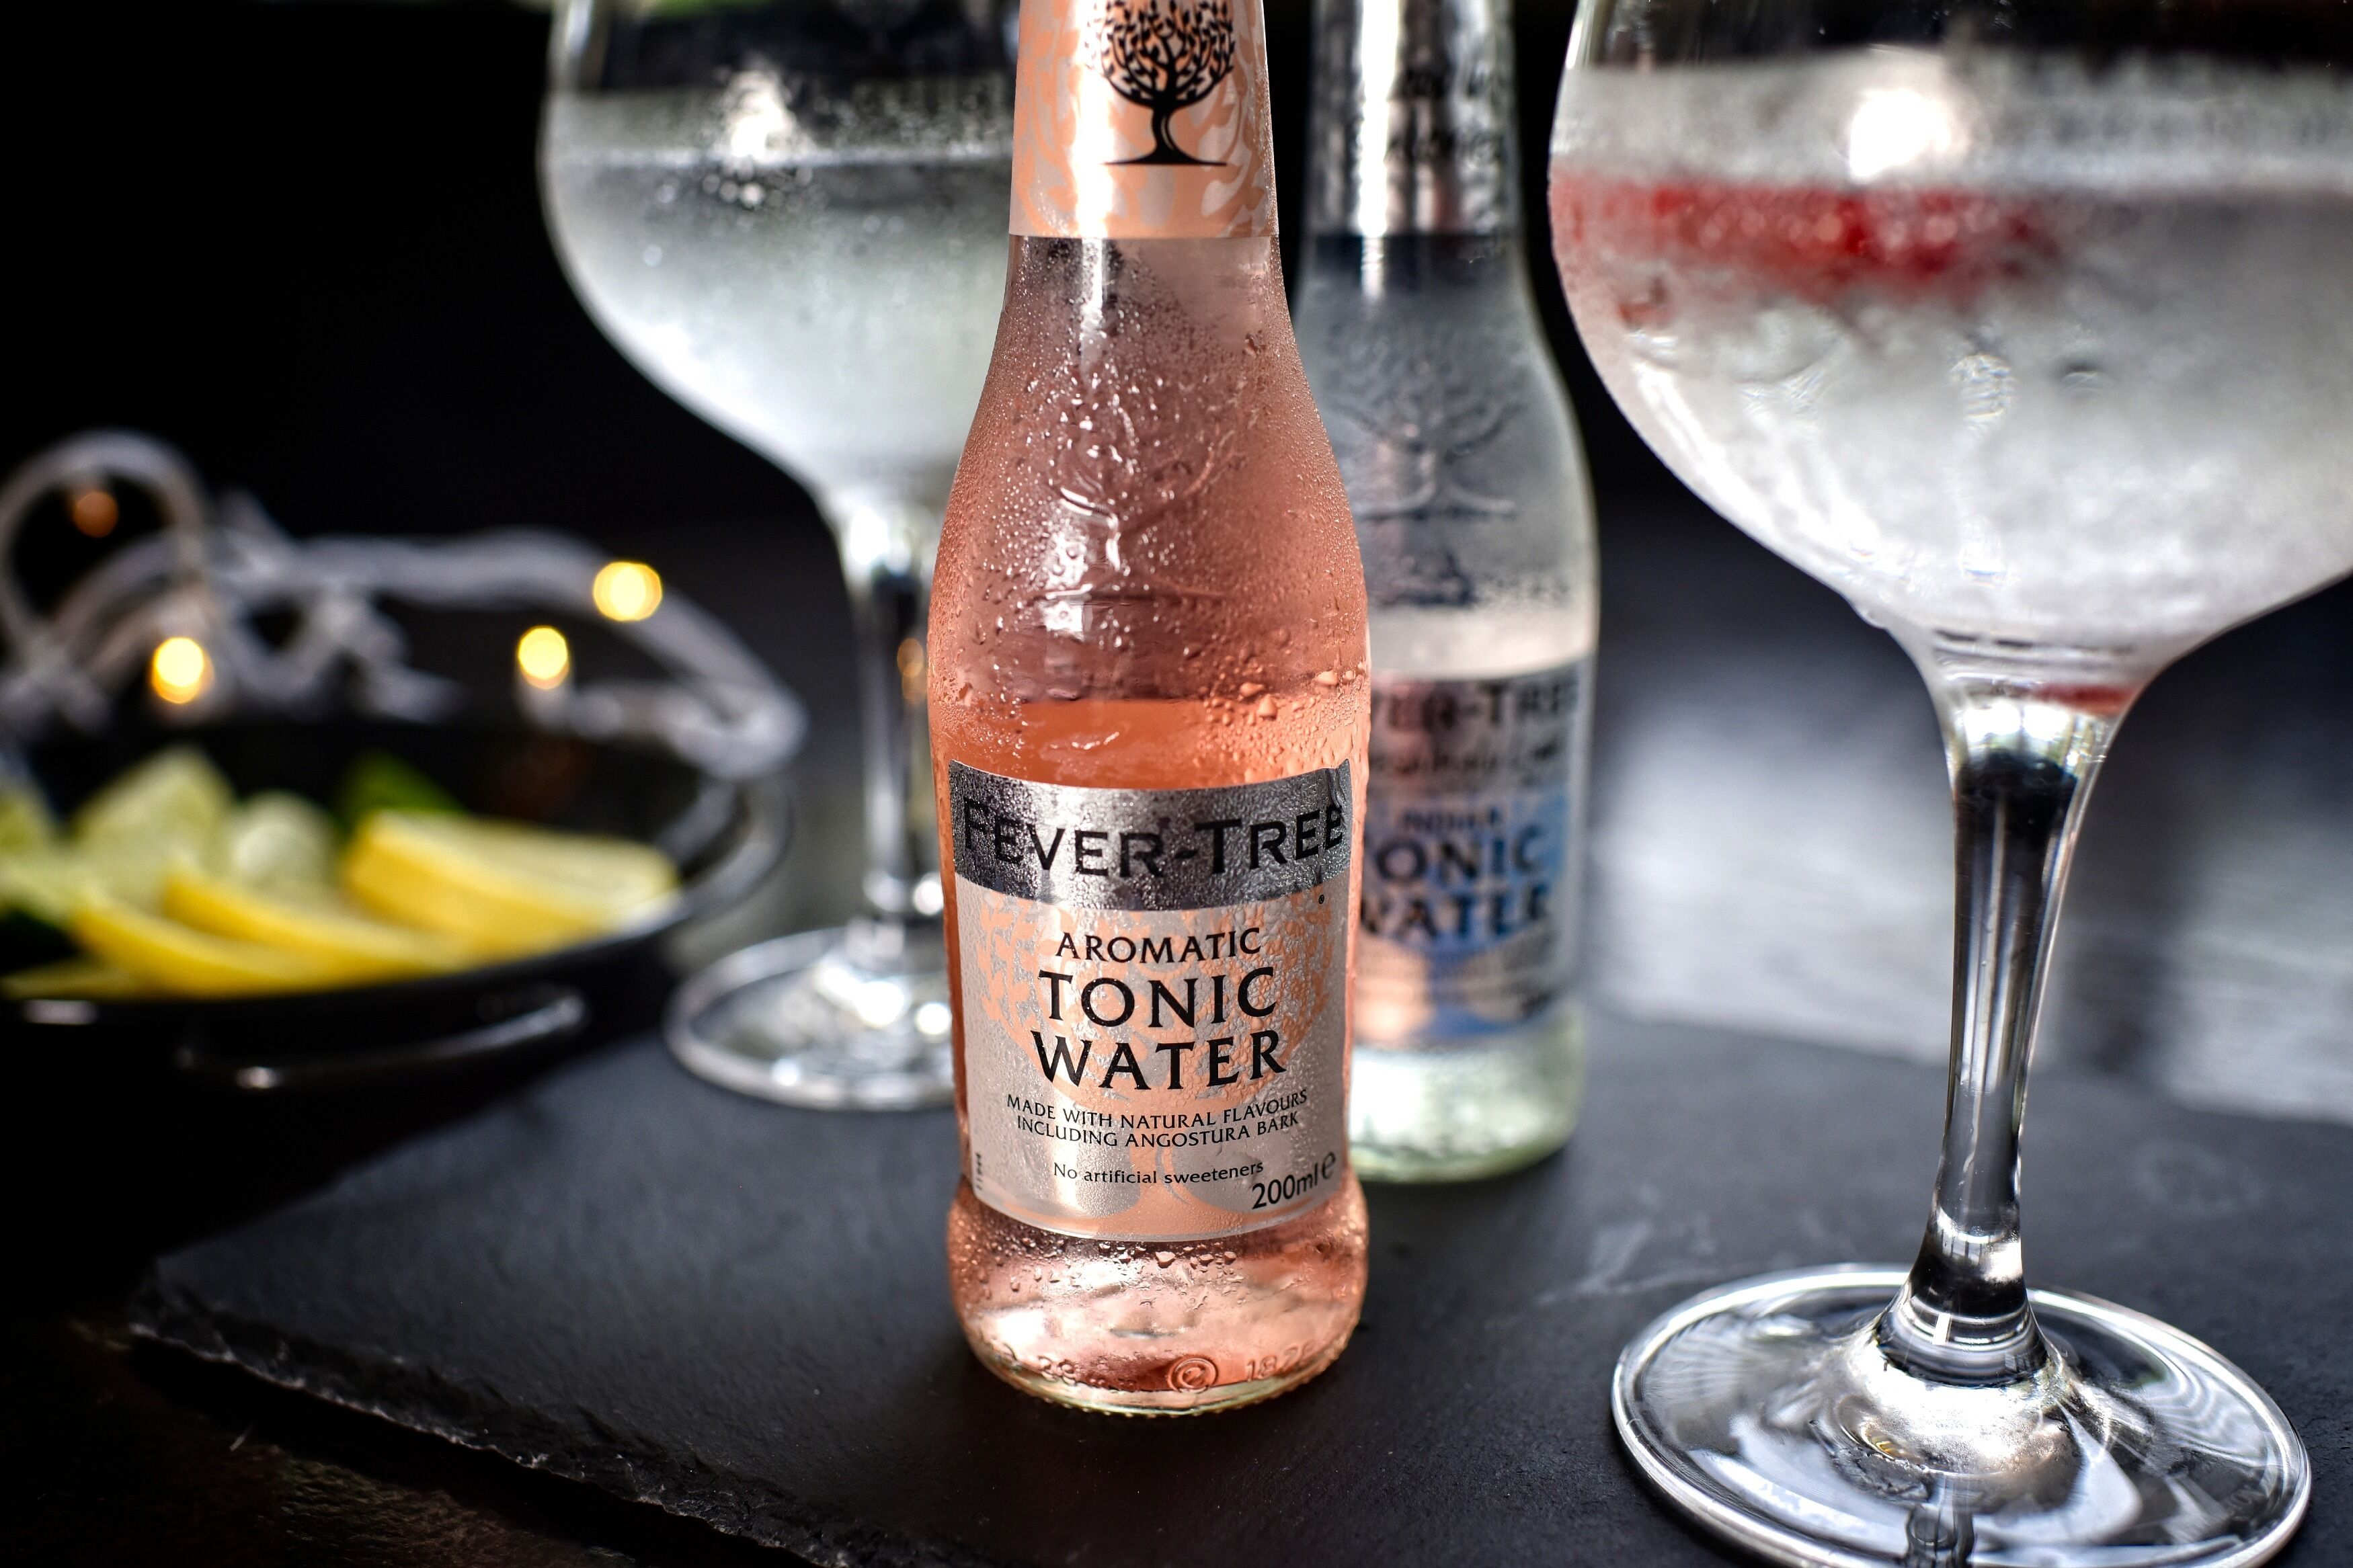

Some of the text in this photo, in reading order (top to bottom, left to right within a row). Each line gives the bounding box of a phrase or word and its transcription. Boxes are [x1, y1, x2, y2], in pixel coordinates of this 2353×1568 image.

[963, 796, 1343, 878] FEVER-TREE
[1055, 928, 1261, 964] AROMATIC
[1038, 967, 1277, 1028] TONIC
[1030, 1030, 1287, 1090] WATER
[1007, 1089, 1308, 1129] MADE WITH NATURAL FLAVOURS
[1017, 1111, 1299, 1147] INCLUDING ANGOSTURA BARK
[1053, 1161, 1264, 1184] No artificial sweeteners
[1251, 1163, 1318, 1209] 200ml
